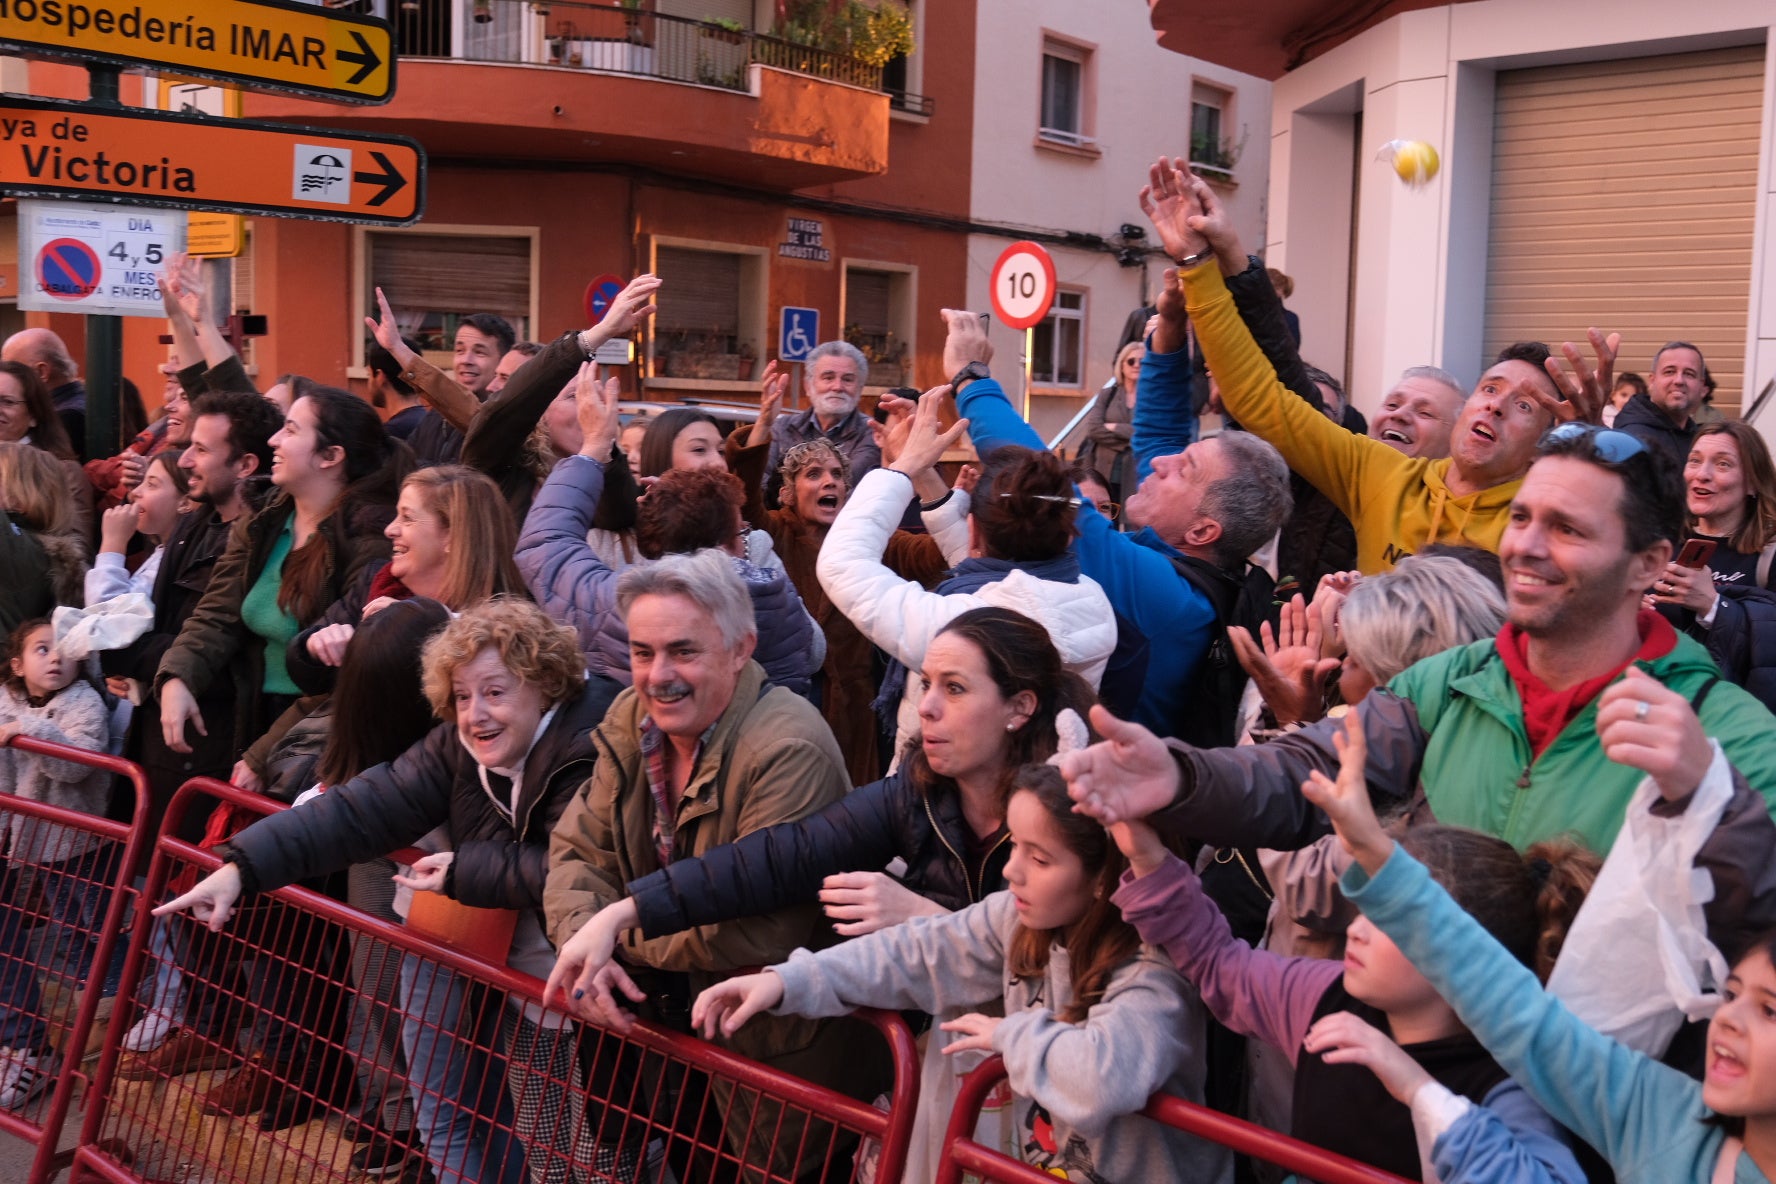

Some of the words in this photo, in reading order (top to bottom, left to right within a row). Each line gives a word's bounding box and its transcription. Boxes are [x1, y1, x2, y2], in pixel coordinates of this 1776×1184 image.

[230, 23, 327, 70] IMAR
[0, 118, 36, 140] ya
[52, 117, 89, 142] de
[21, 144, 196, 193] Victoria
[788, 219, 823, 233] VIRGEN
[787, 231, 800, 244] DE
[804, 234, 823, 247] LAS
[108, 241, 129, 262] 4
[131, 256, 140, 268] y
[145, 243, 163, 265] 5
[779, 245, 829, 261] ANGUSTIAS
[124, 271, 156, 286] MES
[1008, 272, 1036, 299] 10
[112, 285, 163, 301] ENERO
